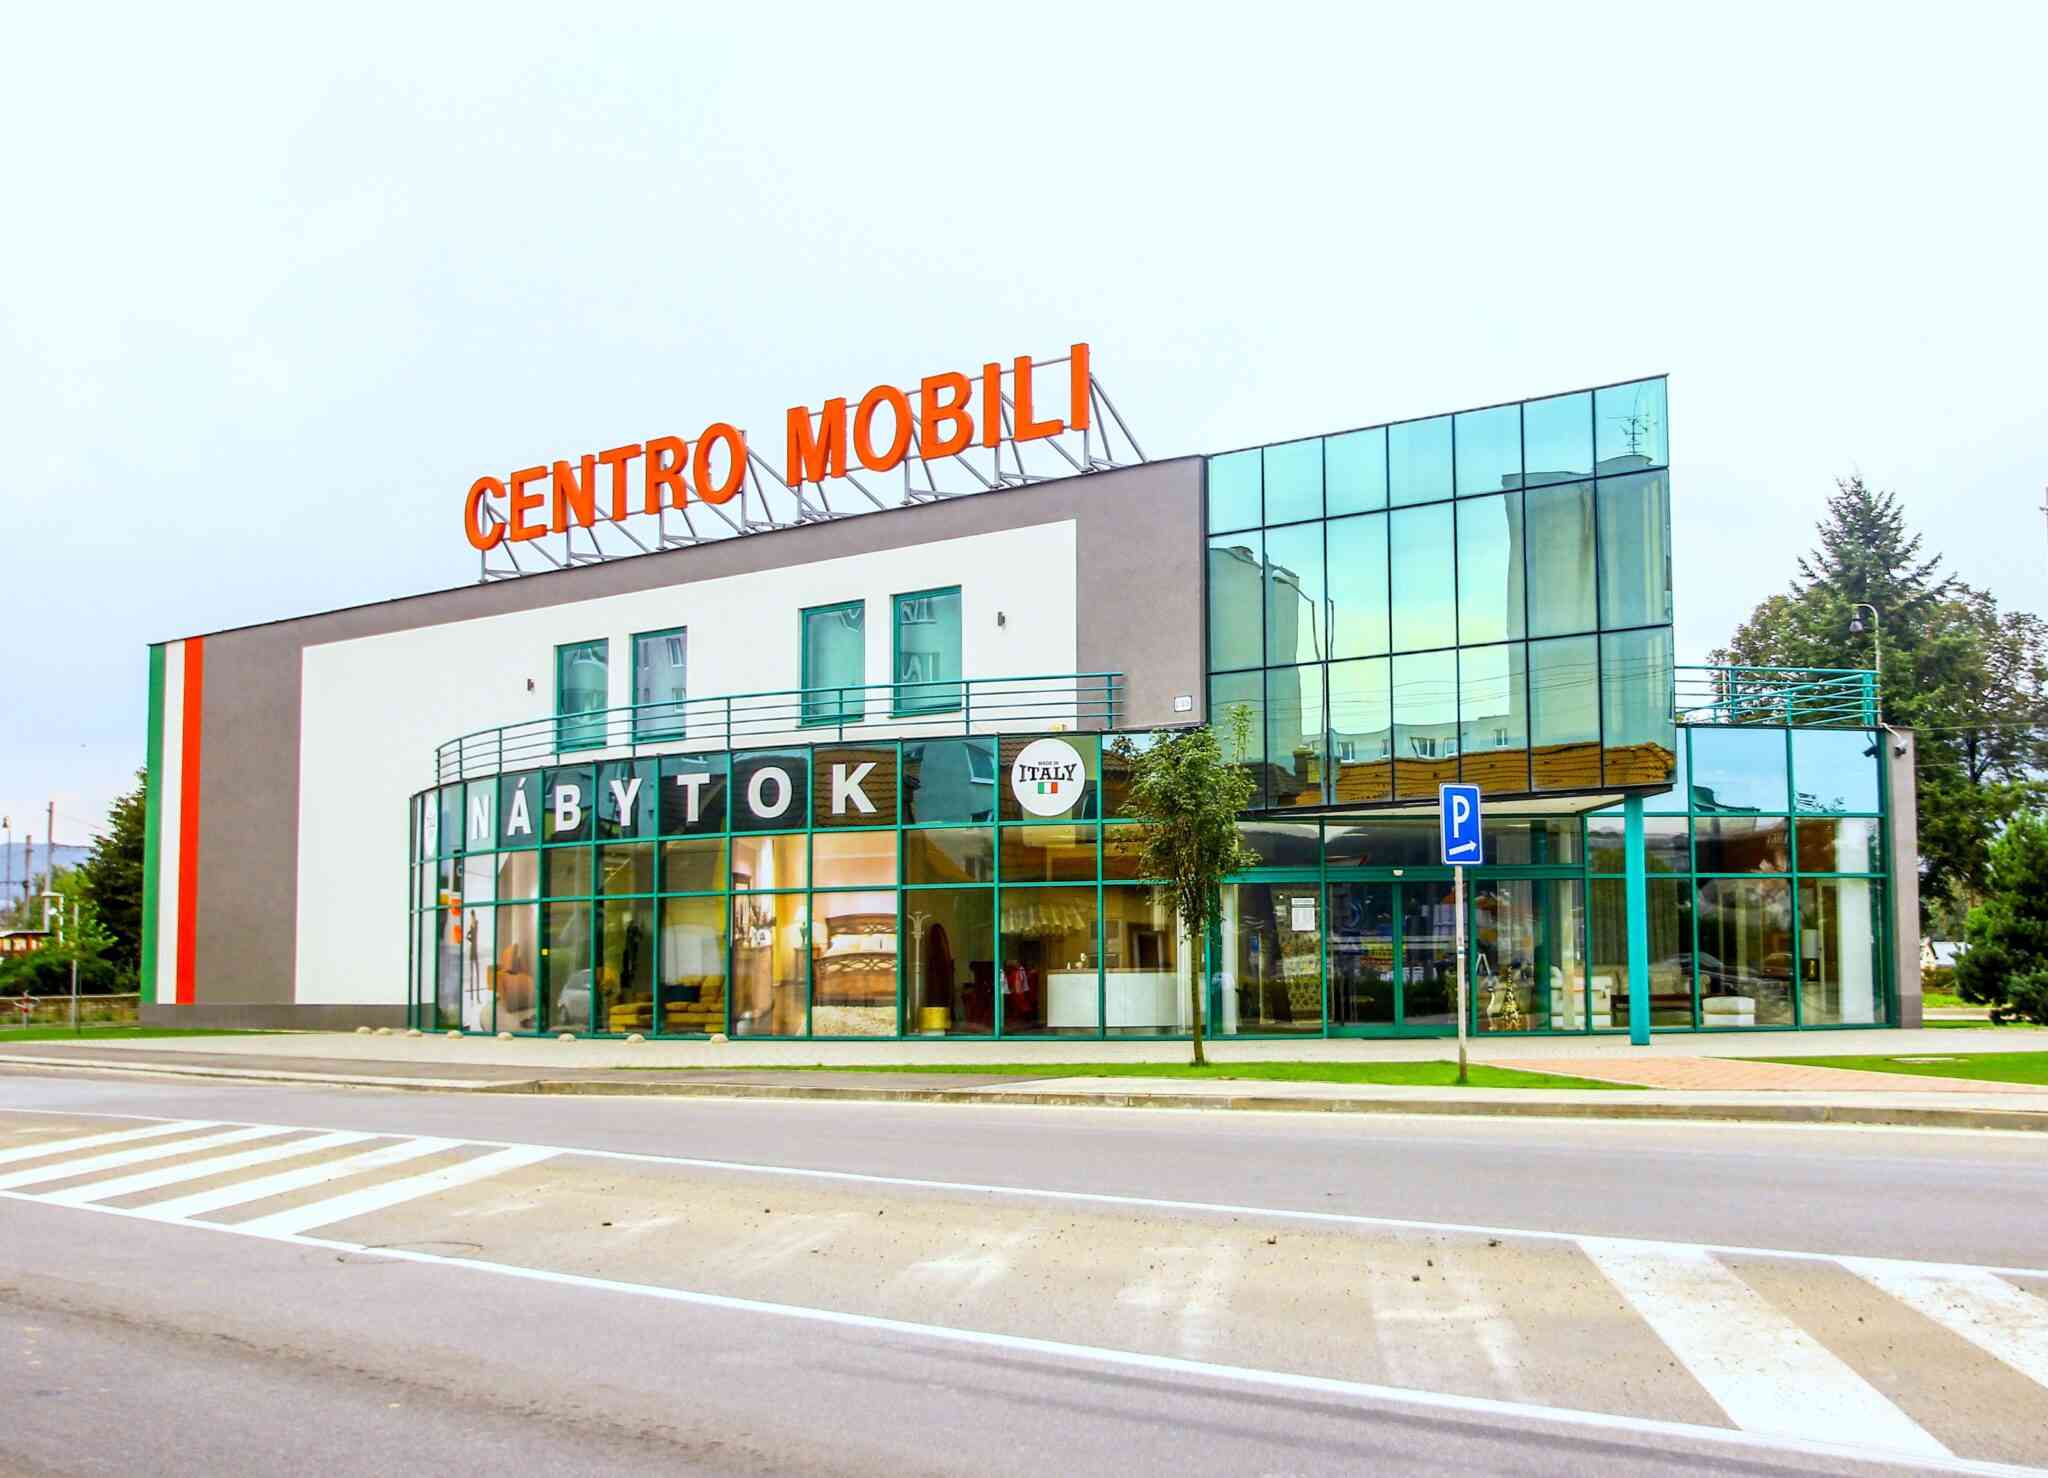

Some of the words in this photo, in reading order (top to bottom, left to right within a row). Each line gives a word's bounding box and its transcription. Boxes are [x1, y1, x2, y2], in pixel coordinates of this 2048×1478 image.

[464, 422, 747, 551] CENTRO
[787, 343, 1089, 487] MOBILI
[469, 761, 878, 841] NÁBYTOK
[1018, 763, 1078, 783] ITALY
[1452, 795, 1471, 839] P
